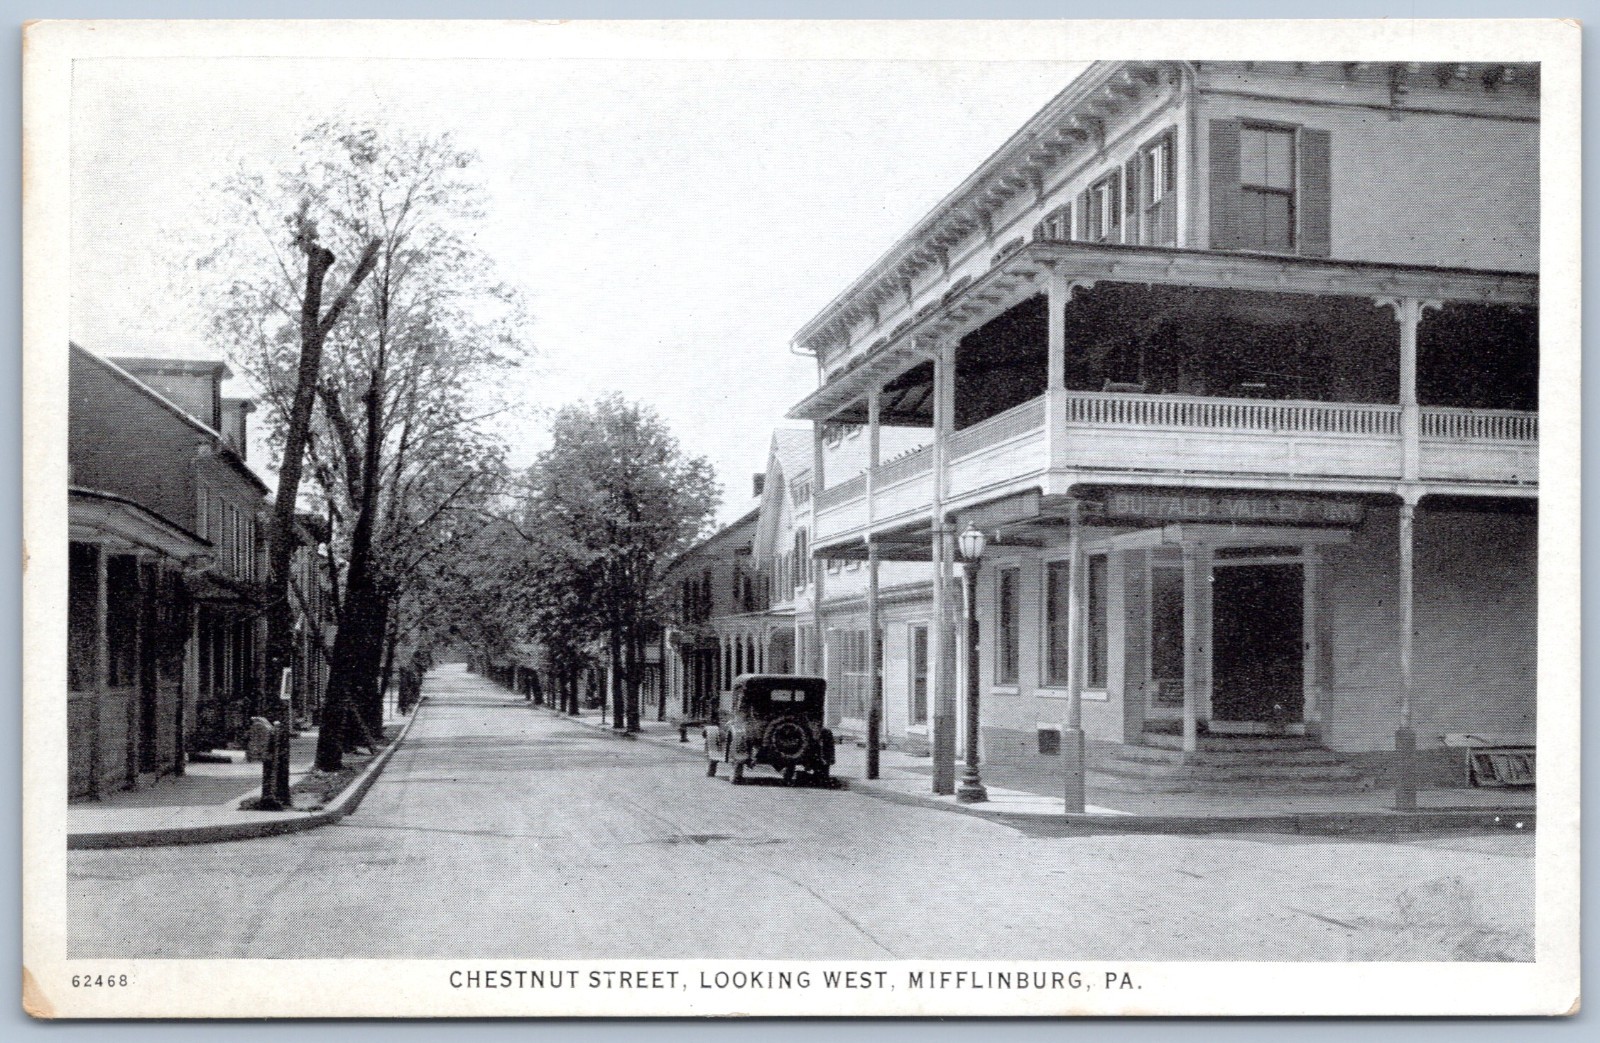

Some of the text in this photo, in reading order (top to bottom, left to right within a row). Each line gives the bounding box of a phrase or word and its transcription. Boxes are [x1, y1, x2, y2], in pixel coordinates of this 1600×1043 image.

[1114, 494, 1358, 520] BUFFALO VALLEY INN
